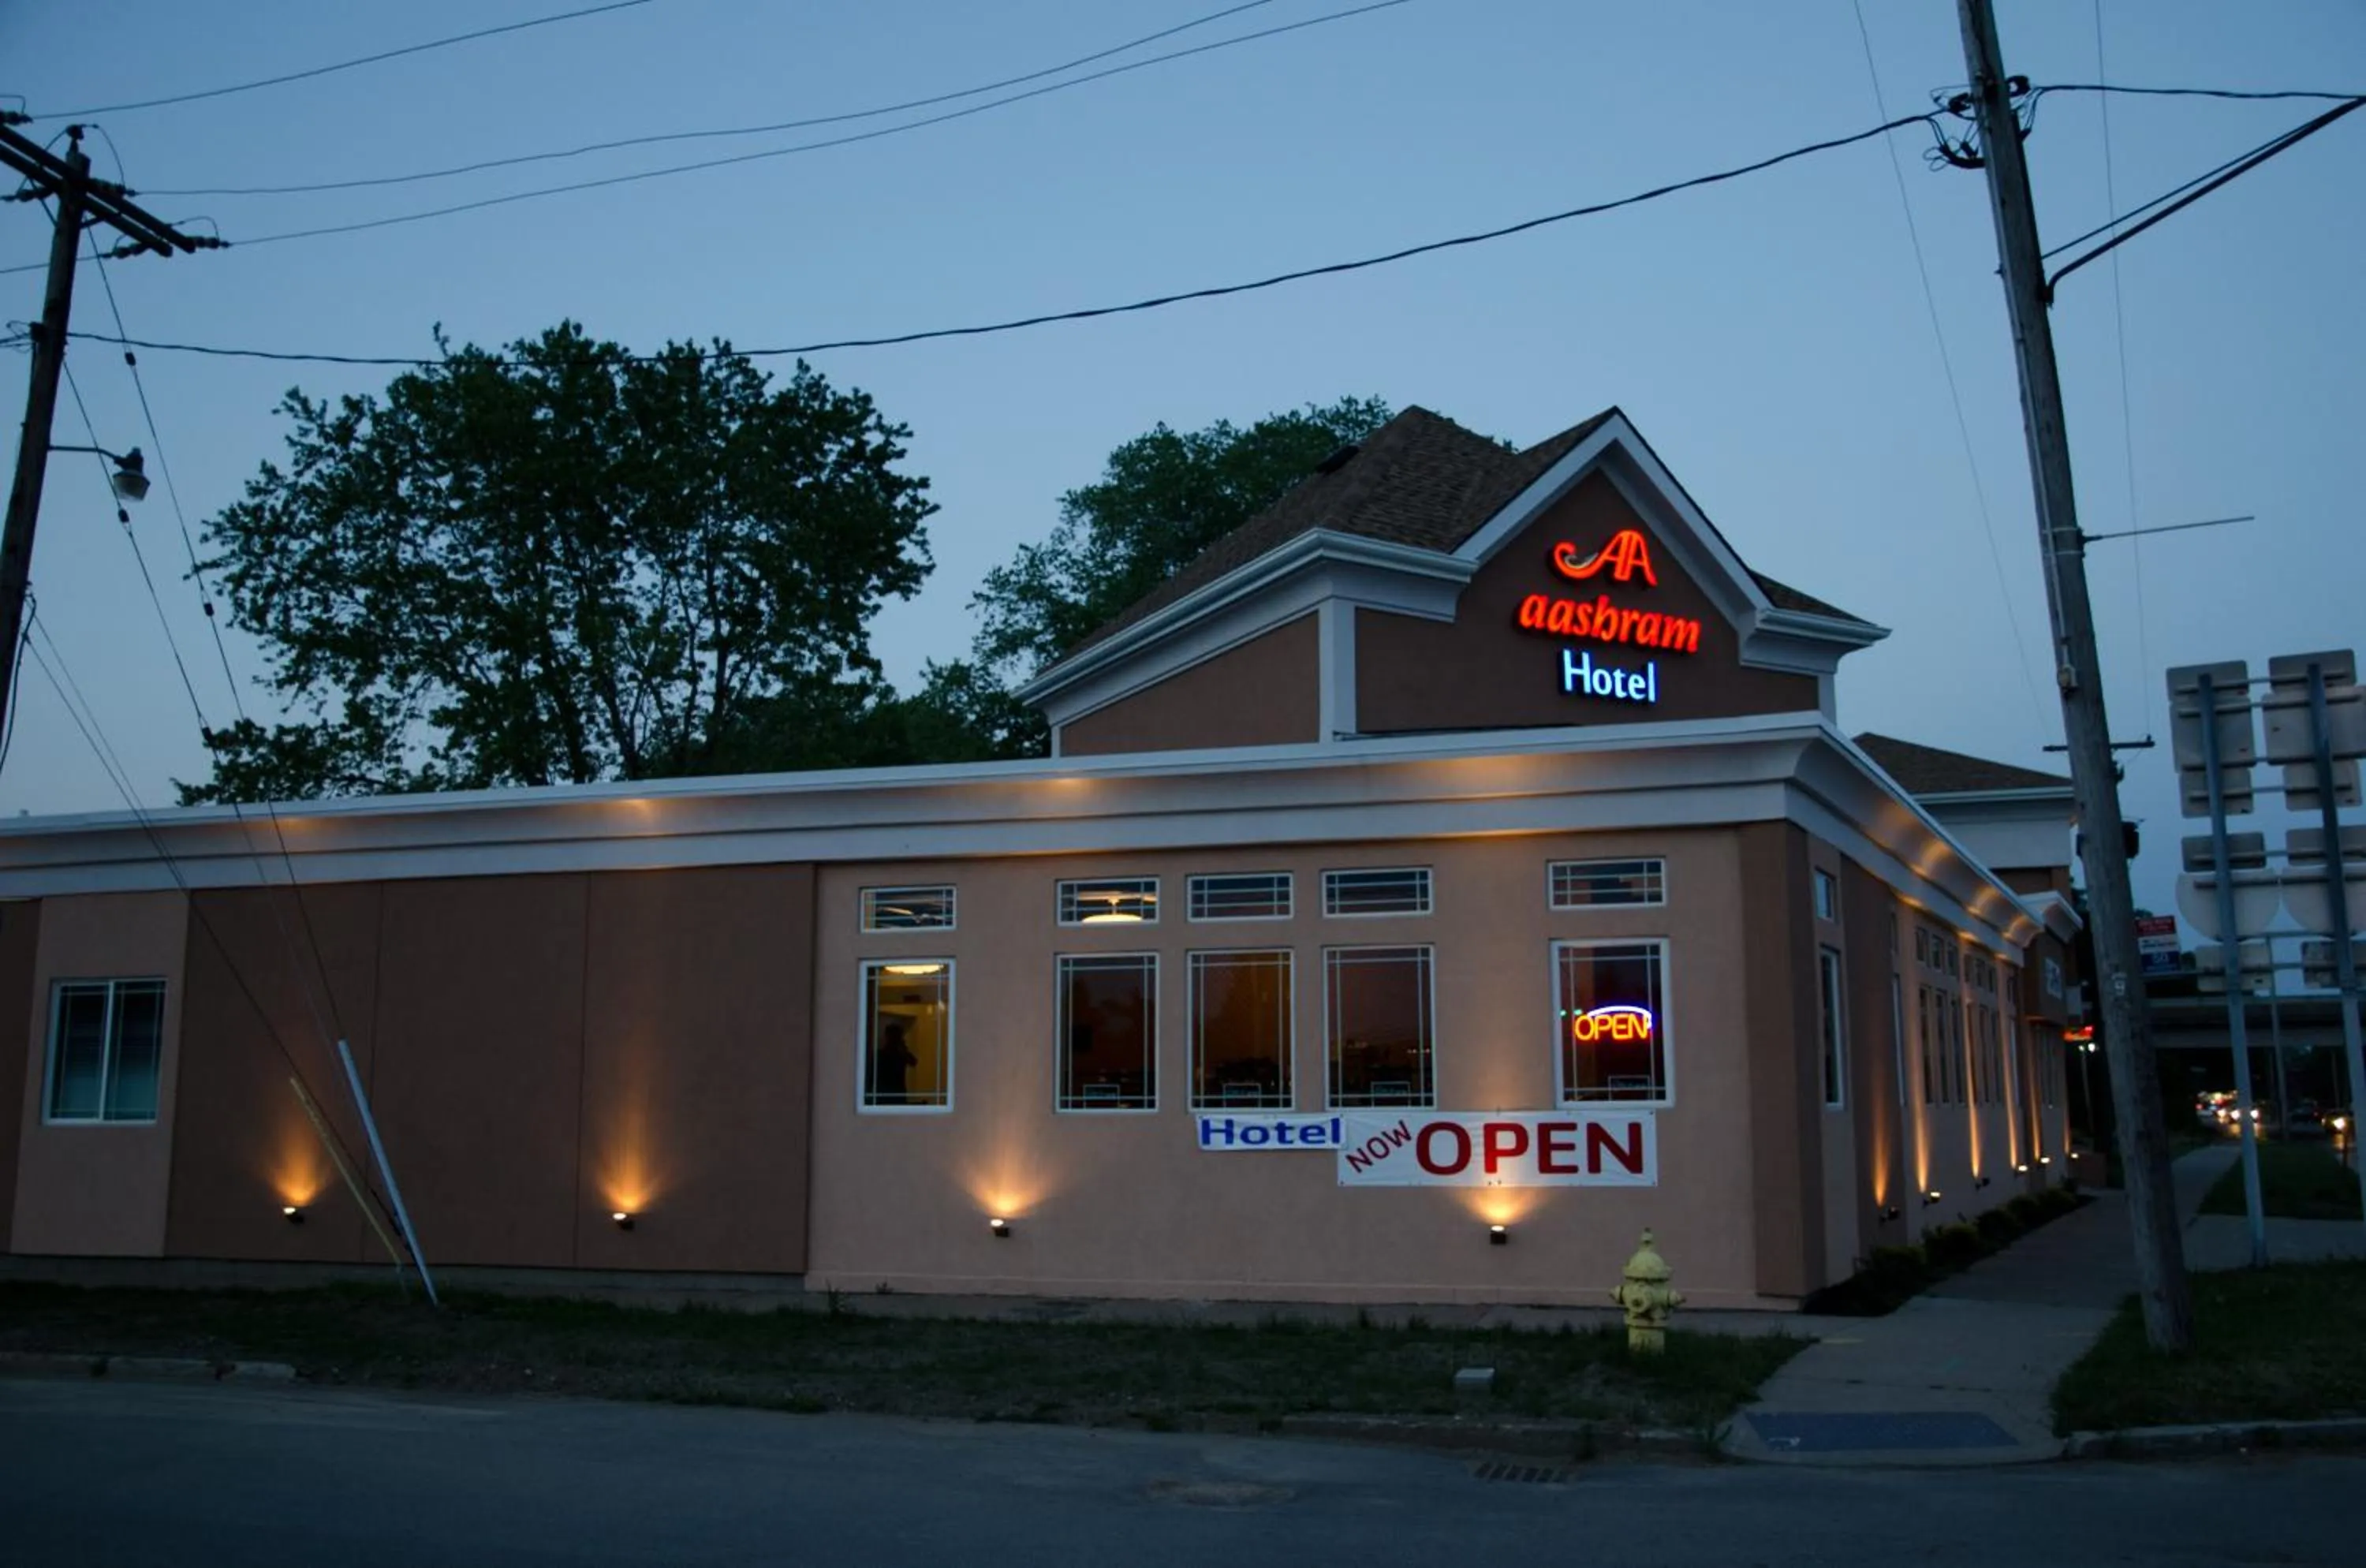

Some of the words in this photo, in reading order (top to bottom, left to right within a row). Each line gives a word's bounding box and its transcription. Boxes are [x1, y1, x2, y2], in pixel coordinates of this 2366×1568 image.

[1519, 593, 1701, 653] aashram
[1563, 648, 1656, 703] Hotel
[1574, 1013, 1648, 1042] OPEN
[1200, 1117, 1341, 1146] Hotel
[1345, 1120, 1412, 1174] NOW
[1416, 1121, 1644, 1176] OPEN
